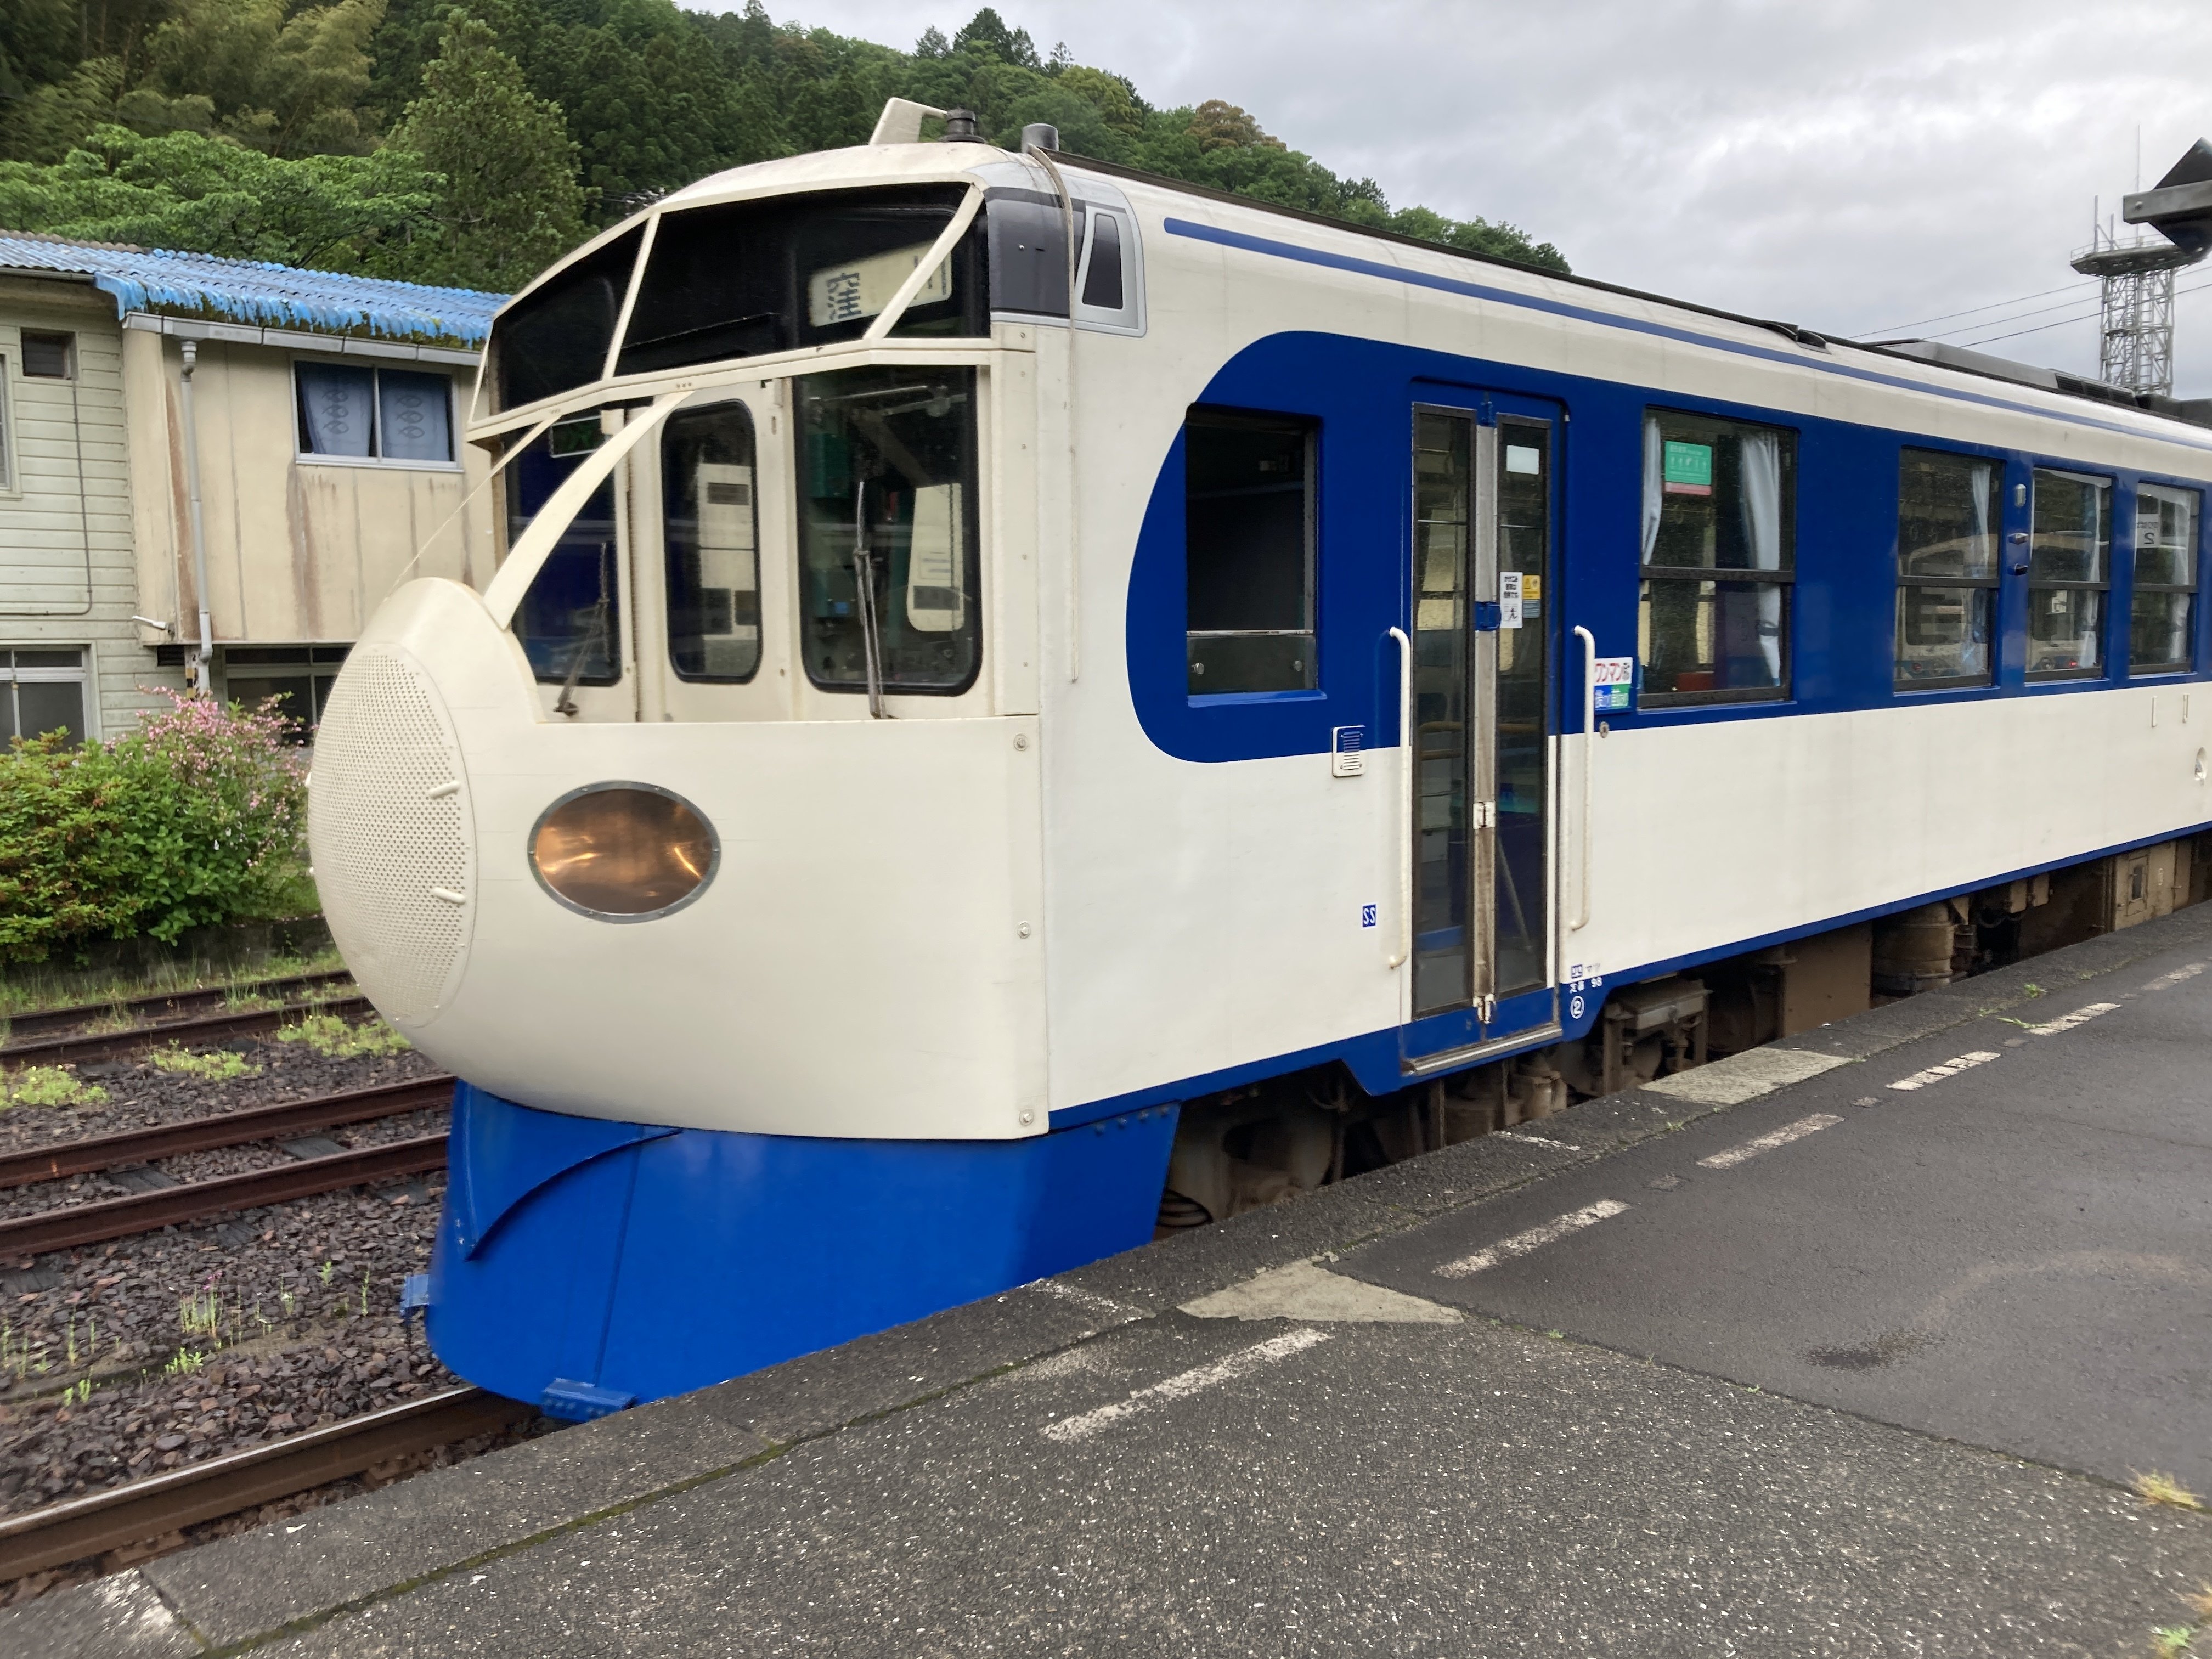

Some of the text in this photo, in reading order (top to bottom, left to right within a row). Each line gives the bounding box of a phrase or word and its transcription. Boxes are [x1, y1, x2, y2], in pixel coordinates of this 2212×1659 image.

[1594, 663, 1624, 682] ワンマン
[1363, 906, 1376, 925] SS
